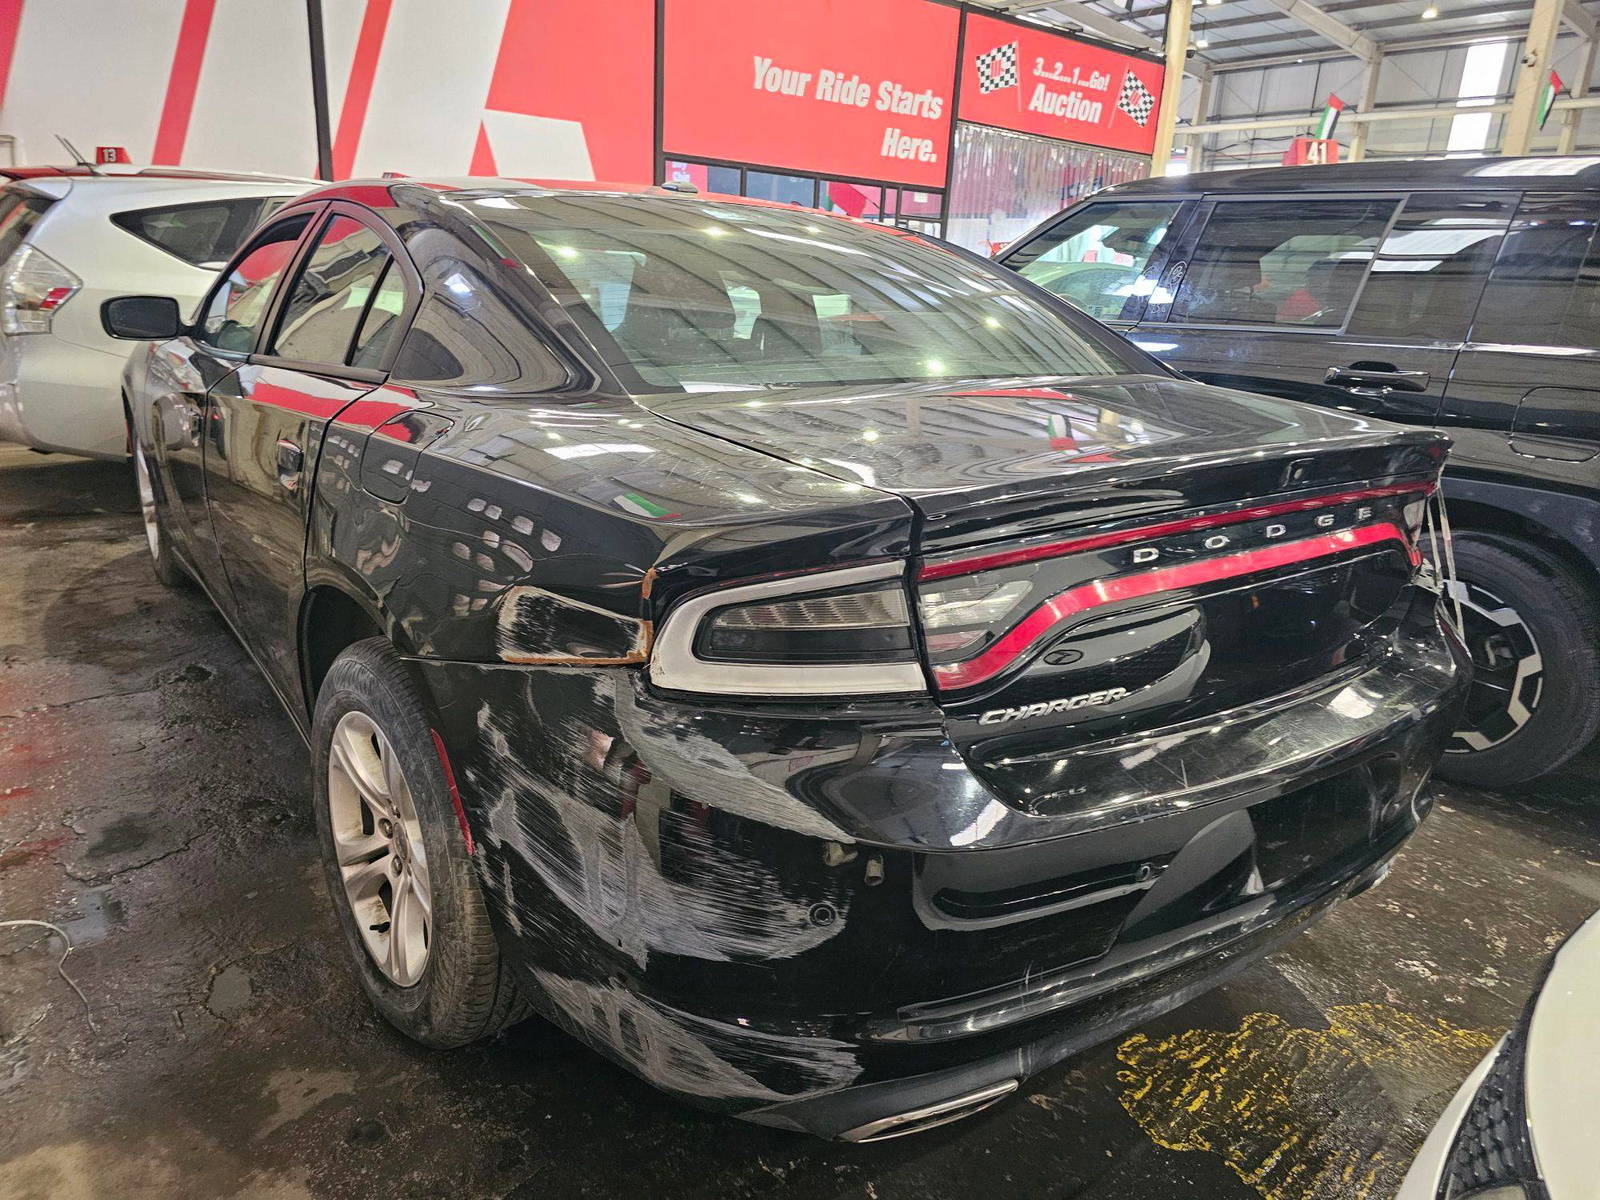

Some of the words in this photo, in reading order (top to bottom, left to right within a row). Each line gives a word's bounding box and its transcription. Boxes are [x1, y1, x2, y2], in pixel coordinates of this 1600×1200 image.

[753, 55, 812, 97] Your
[815, 68, 871, 108] Ride
[875, 80, 944, 120] Starts
[1028, 82, 1103, 124] Auction
[103, 148, 117, 162] 13
[880, 127, 937, 163] Here.
[1306, 141, 1328, 164] 41
[1132, 506, 1372, 564] DODGE
[977, 686, 1132, 726] CHARGER
